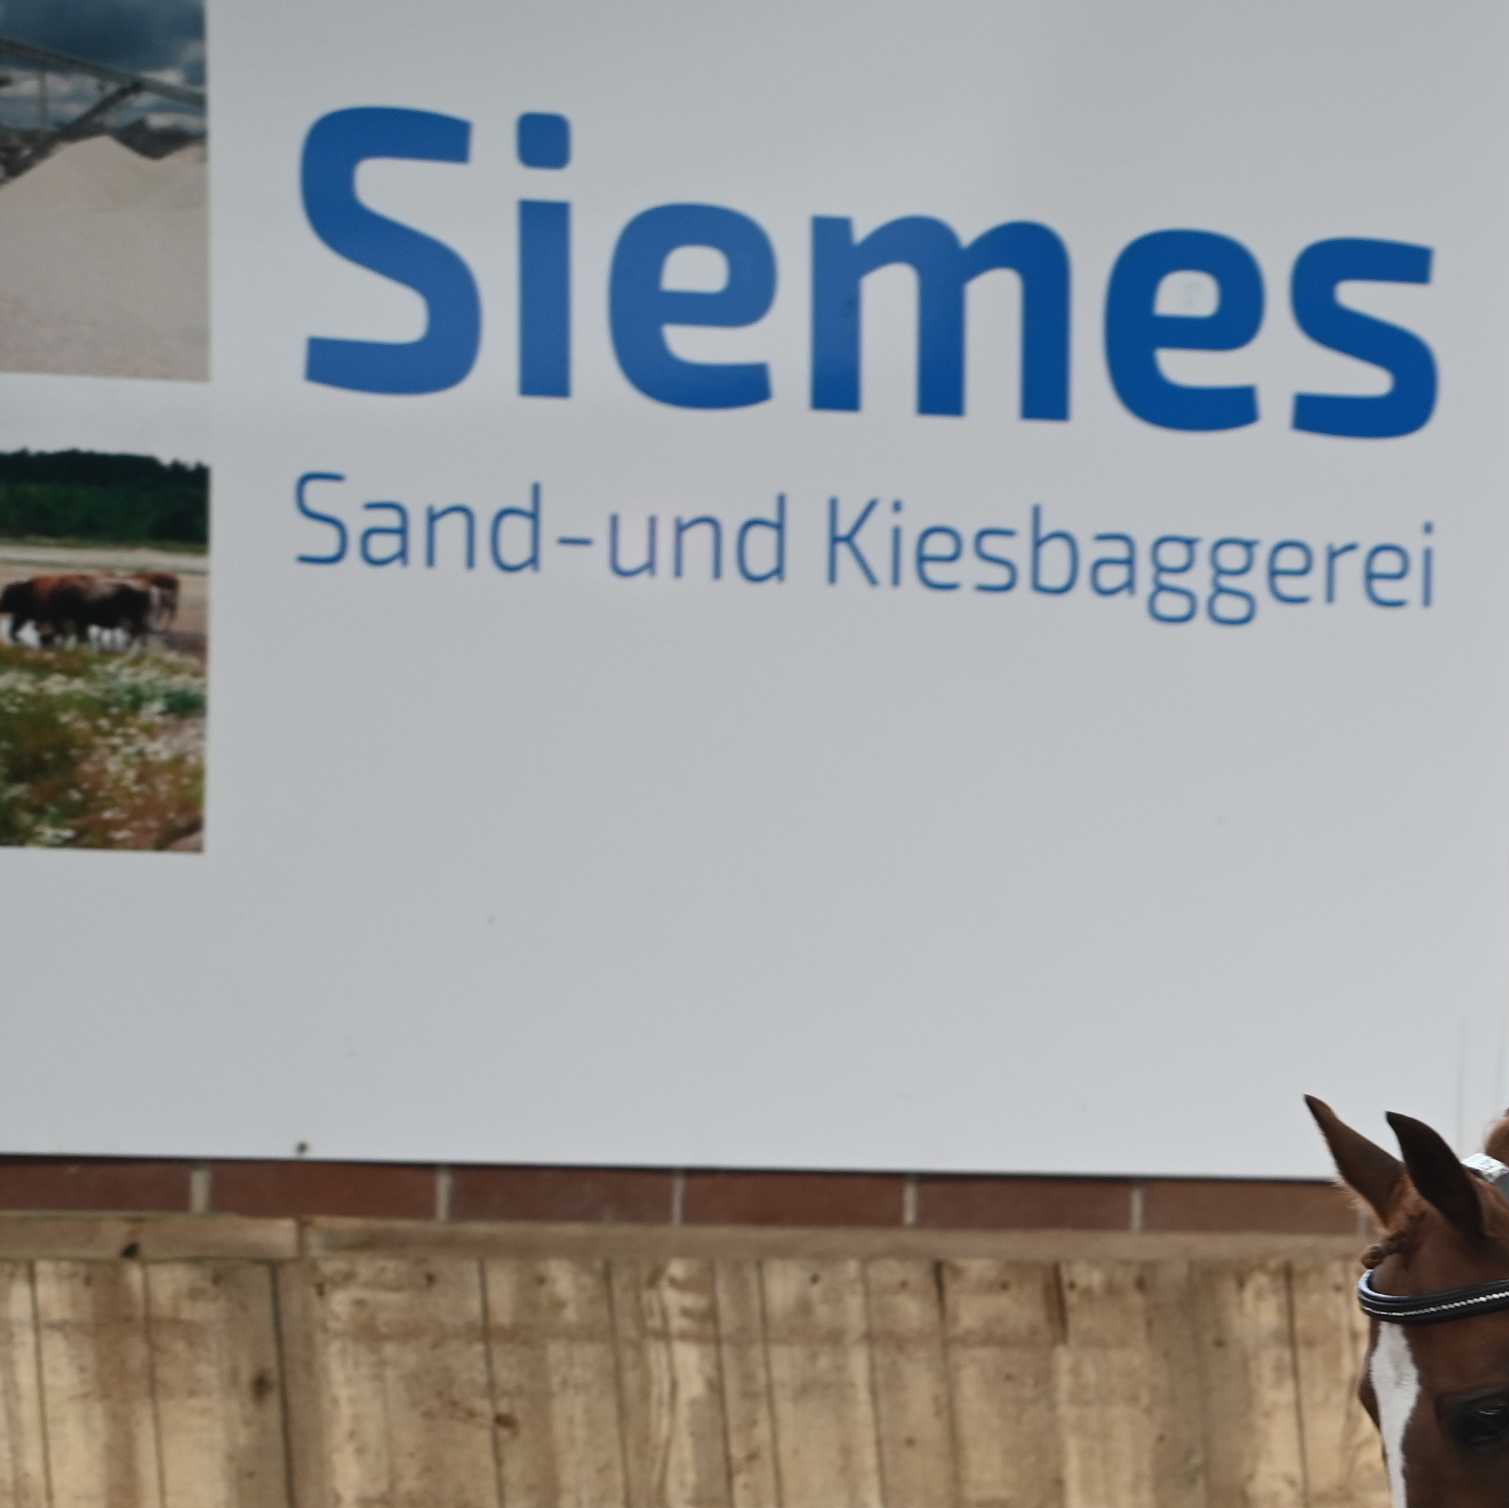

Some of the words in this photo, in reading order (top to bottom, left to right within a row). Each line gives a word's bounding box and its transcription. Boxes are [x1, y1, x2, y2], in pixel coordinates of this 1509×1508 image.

[299, 105, 1439, 440] Siemes
[294, 471, 786, 584] Sand-und
[827, 496, 1433, 627] Kiesbaggerei
